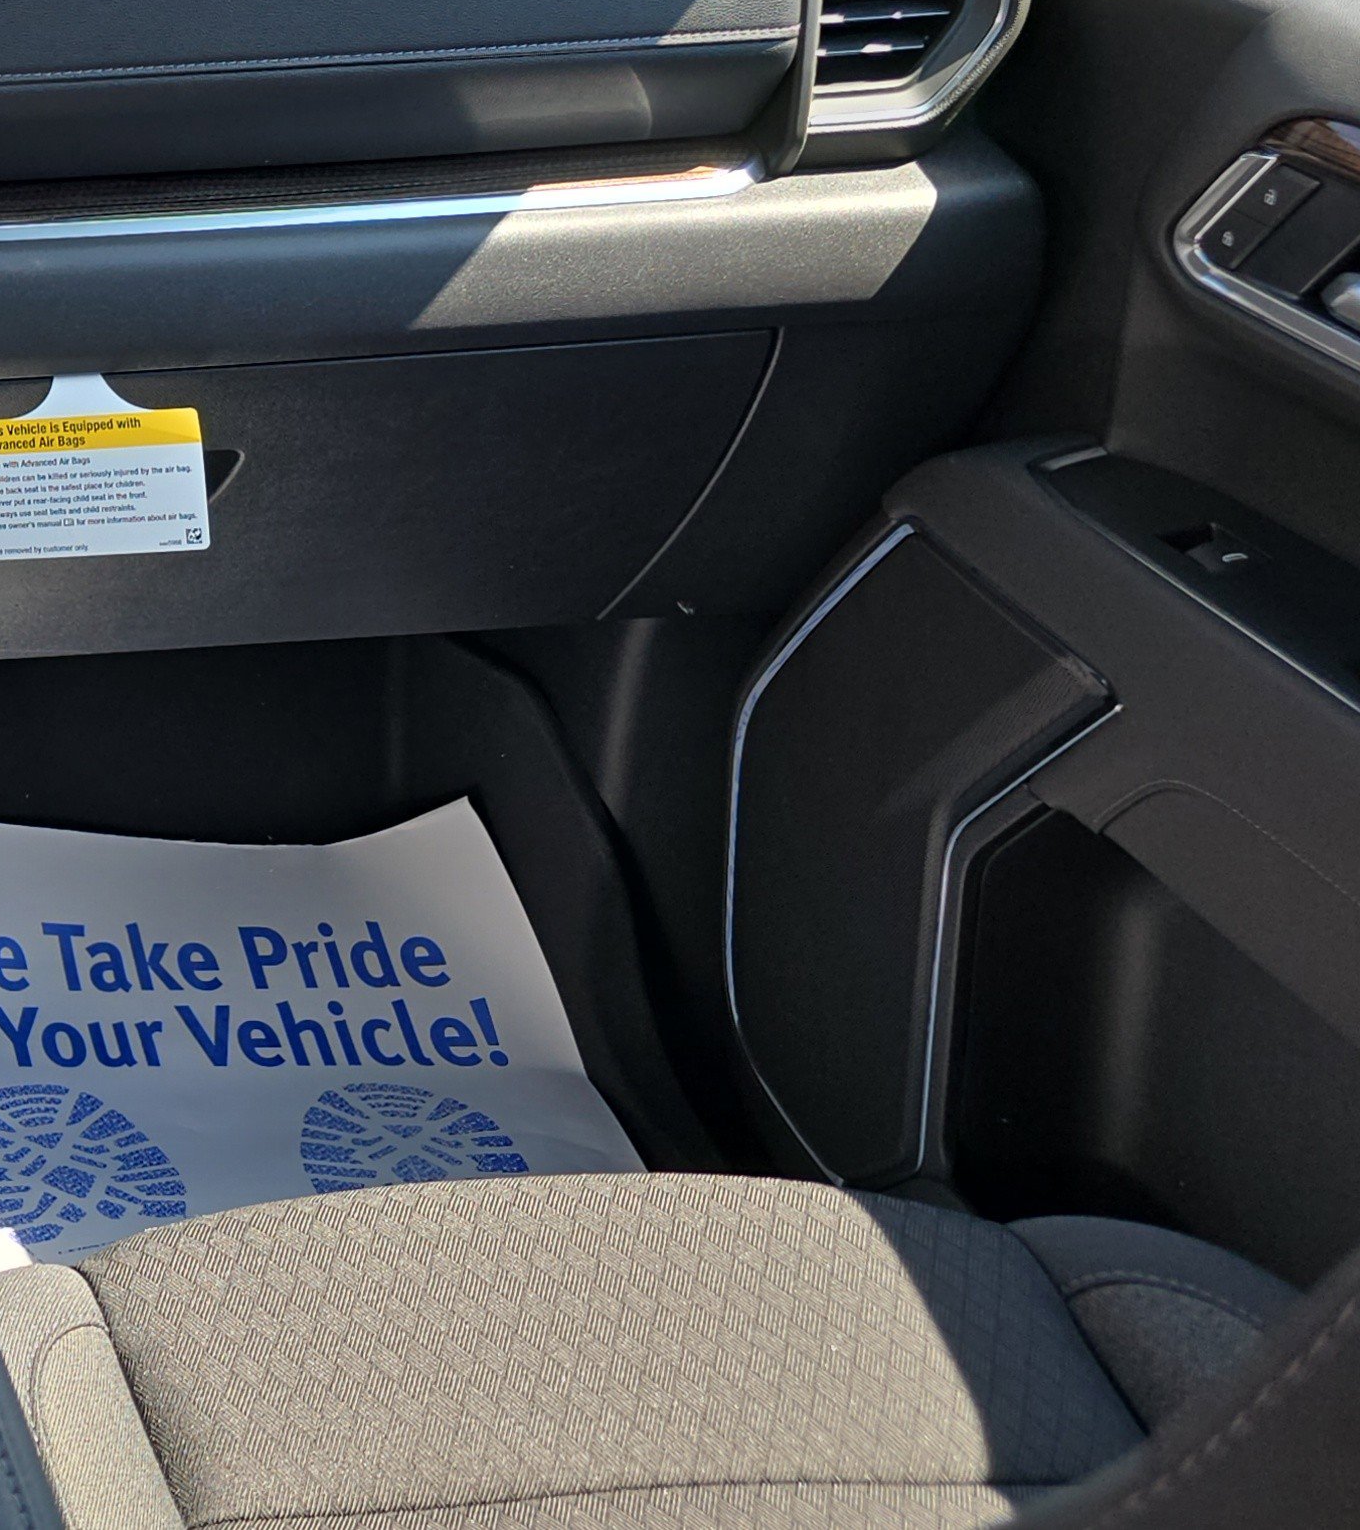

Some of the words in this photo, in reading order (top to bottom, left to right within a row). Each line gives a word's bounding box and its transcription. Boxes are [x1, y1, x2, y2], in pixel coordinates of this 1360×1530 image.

[6, 423, 47, 435] Vehicle
[50, 422, 60, 433] is
[63, 419, 114, 434] Equipped
[116, 417, 141, 429] with
[39, 436, 54, 447] Air
[58, 435, 86, 449] Bags
[2, 460, 19, 468] with
[21, 458, 57, 468] Advanced
[72, 457, 90, 466] Bags
[37, 473, 46, 481] be
[48, 472, 68, 481] killed
[79, 470, 111, 480] seriously
[113, 468, 139, 478] injured
[140, 468, 150, 476] by
[5, 486, 22, 494] back
[24, 485, 39, 493] seat
[40, 484, 47, 492] is
[48, 484, 59, 492] the
[61, 483, 82, 491] safest
[84, 482, 102, 492] place
[104, 481, 114, 489] for
[115, 479, 145, 488] children.
[41, 921, 220, 994] Take
[238, 920, 451, 990] Pride
[174, 997, 509, 1069] Vehicle!
